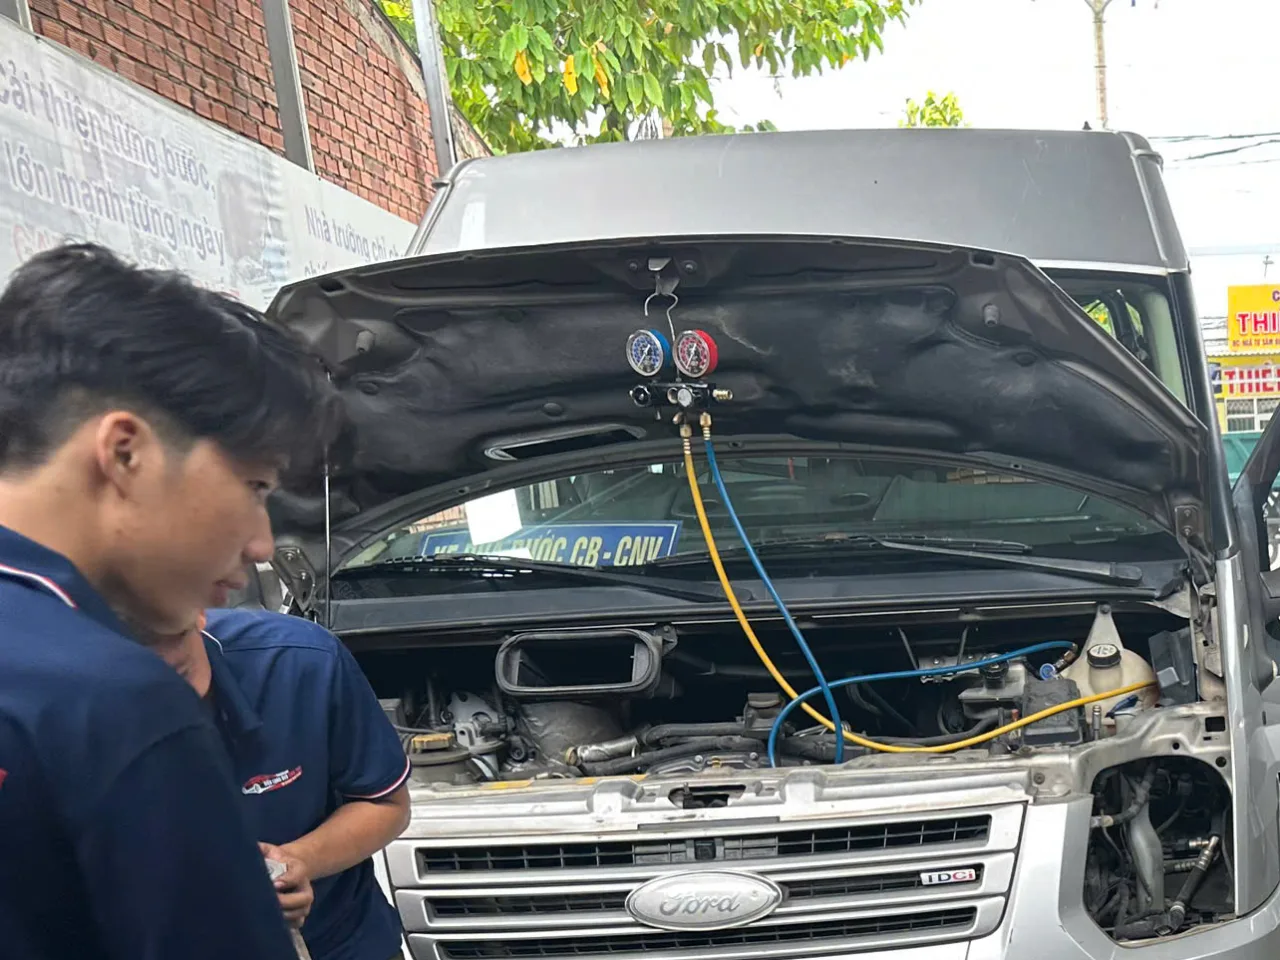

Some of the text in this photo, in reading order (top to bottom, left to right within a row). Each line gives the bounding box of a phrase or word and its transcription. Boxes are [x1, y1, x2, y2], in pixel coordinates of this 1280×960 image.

[4, 140, 52, 200] lớn
[56, 169, 126, 225] mạnh
[181, 217, 225, 266] ngày
[304, 204, 332, 244] Nhà
[569, 534, 604, 568] CB
[613, 535, 664, 568] CNV
[926, 869, 975, 884] TDCi
[659, 889, 742, 916] Ford
